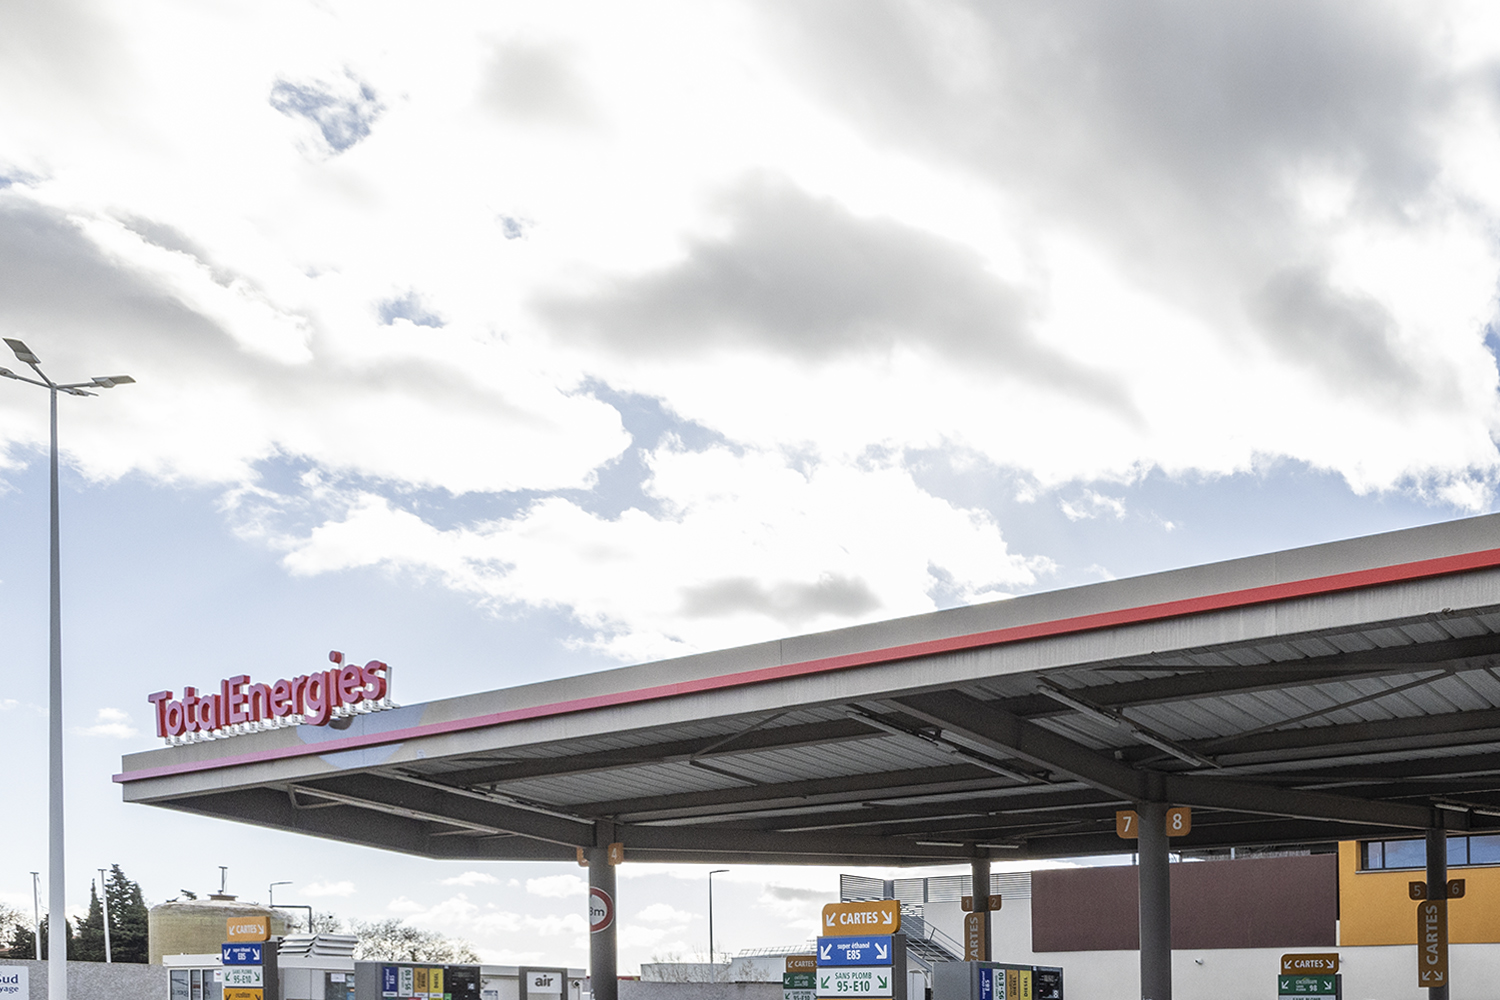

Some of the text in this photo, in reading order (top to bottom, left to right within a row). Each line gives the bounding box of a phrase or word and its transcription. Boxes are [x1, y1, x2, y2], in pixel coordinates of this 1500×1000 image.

[148, 650, 388, 738] TotalEnergies
[1123, 816, 1132, 832] 7
[1172, 813, 1183, 830] 8
[611, 847, 618, 860] 4
[1414, 885, 1421, 896] 5
[1452, 883, 1460, 894] 6
[991, 898, 997, 908] 2
[840, 911, 878, 925] CARTES
[236, 924, 257, 934] CARTES
[1426, 904, 1439, 965] CARTES
[969, 916, 979, 962] ARTES
[846, 950, 861, 960] E85
[1294, 959, 1324, 968] CARTES
[0, 974, 19, 984] ud
[535, 974, 554, 987] air
[835, 972, 872, 980] SANS PLOMB
[837, 980, 870, 992] 95-E10
